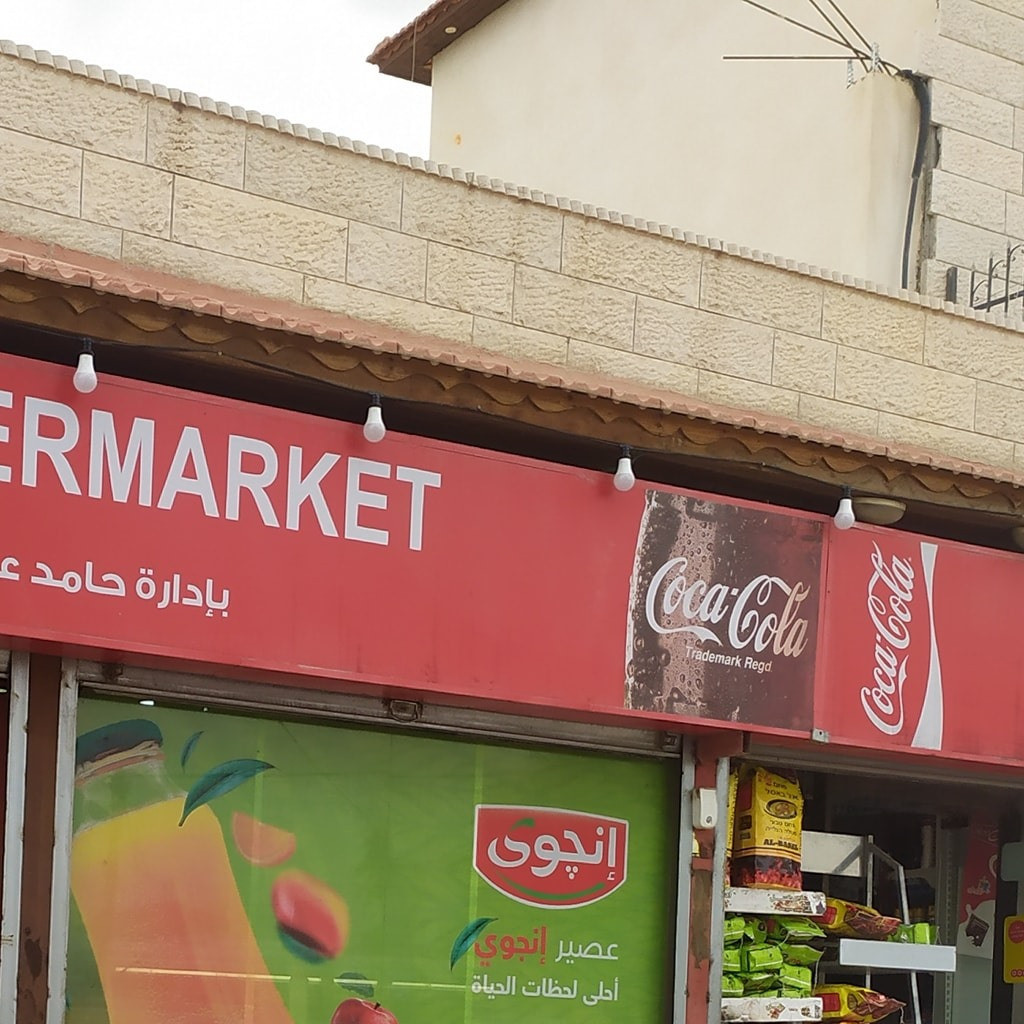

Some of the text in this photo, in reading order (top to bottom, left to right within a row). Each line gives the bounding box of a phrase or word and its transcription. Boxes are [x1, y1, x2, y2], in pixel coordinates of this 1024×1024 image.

[31, 561, 125, 597] حامد
[135, 567, 230, 617] بإدارة
[685, 645, 742, 668] Trademark
[473, 925, 619, 968] عصير إنجوي
[471, 974, 619, 1006] أحلى لحظات الحياة
